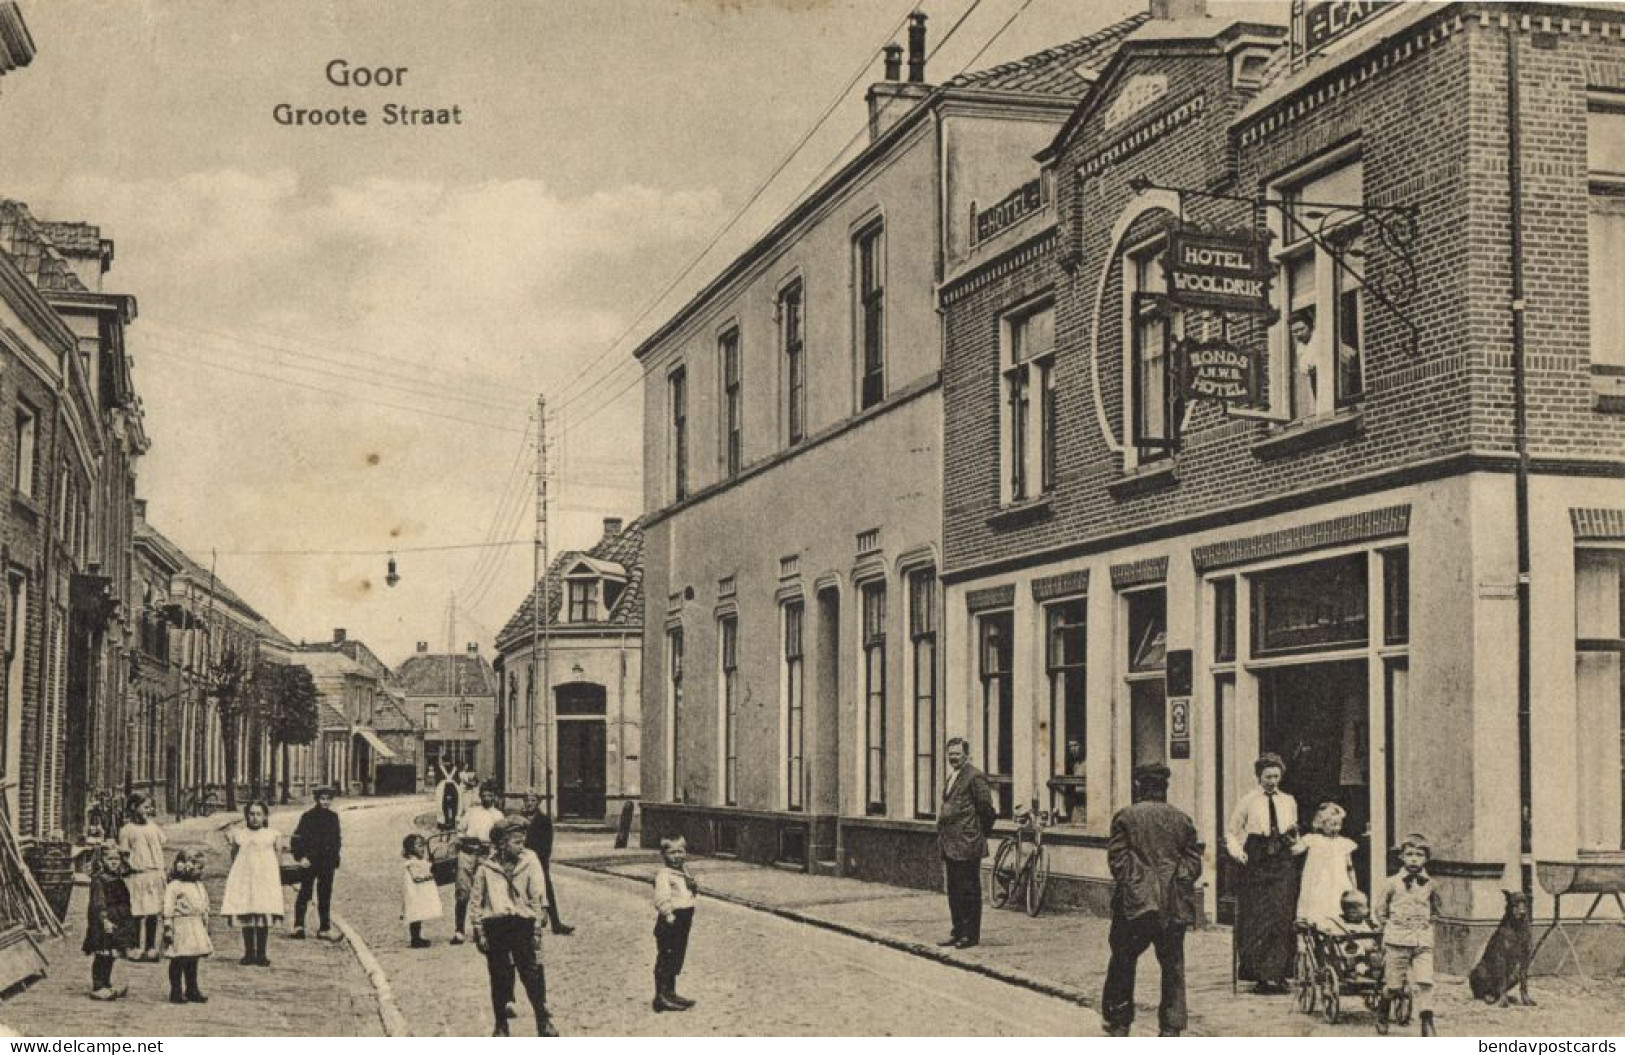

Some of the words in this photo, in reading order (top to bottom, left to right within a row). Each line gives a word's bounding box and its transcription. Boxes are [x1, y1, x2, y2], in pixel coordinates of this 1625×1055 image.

[987, 192, 1030, 237] HOTEL
[1185, 246, 1252, 270] HOTEL
[1190, 376, 1249, 397] HOTEL
